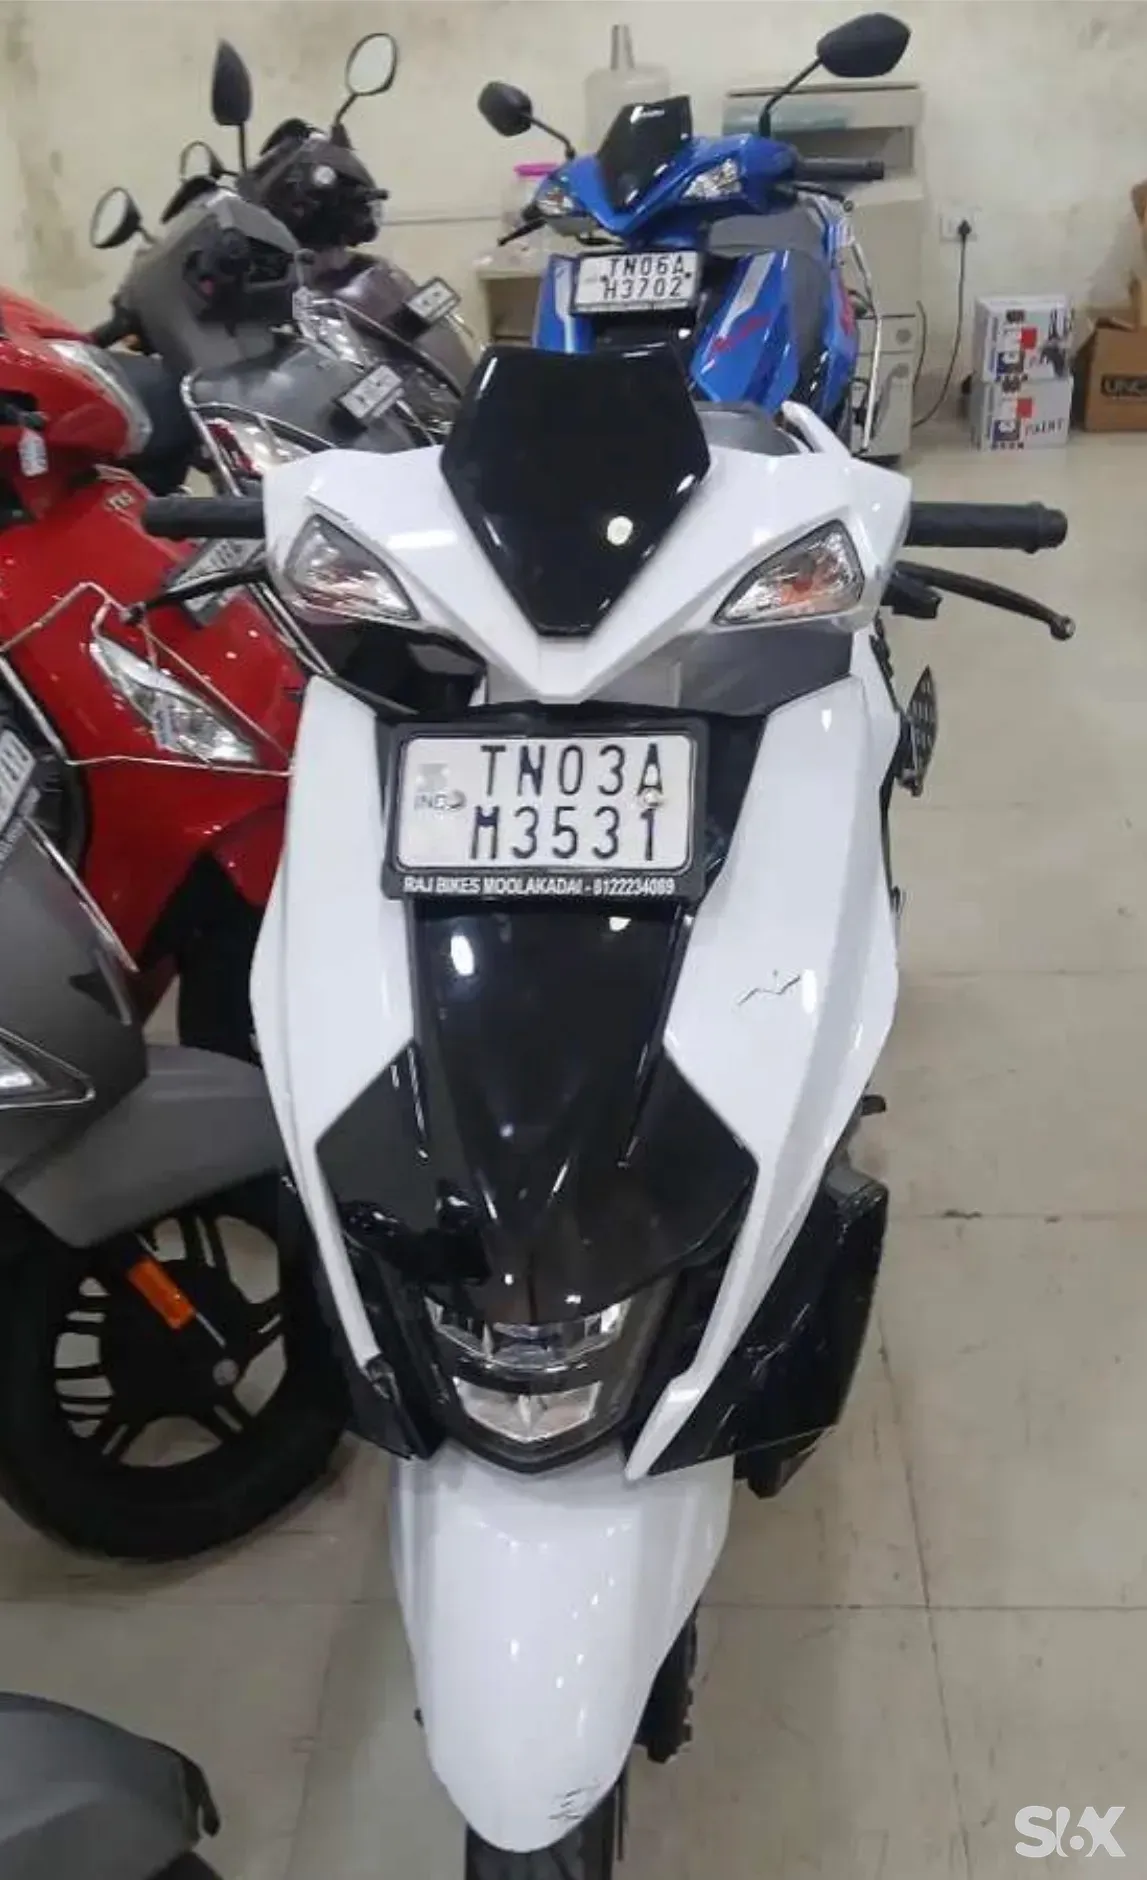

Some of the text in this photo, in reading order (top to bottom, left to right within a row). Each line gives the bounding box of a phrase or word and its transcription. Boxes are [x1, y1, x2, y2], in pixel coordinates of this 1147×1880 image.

[609, 255, 685, 277] TN06A
[603, 277, 683, 299] H3702
[480, 743, 663, 797] TN03A
[471, 805, 659, 861] M3531
[436, 876, 480, 894] BIKES
